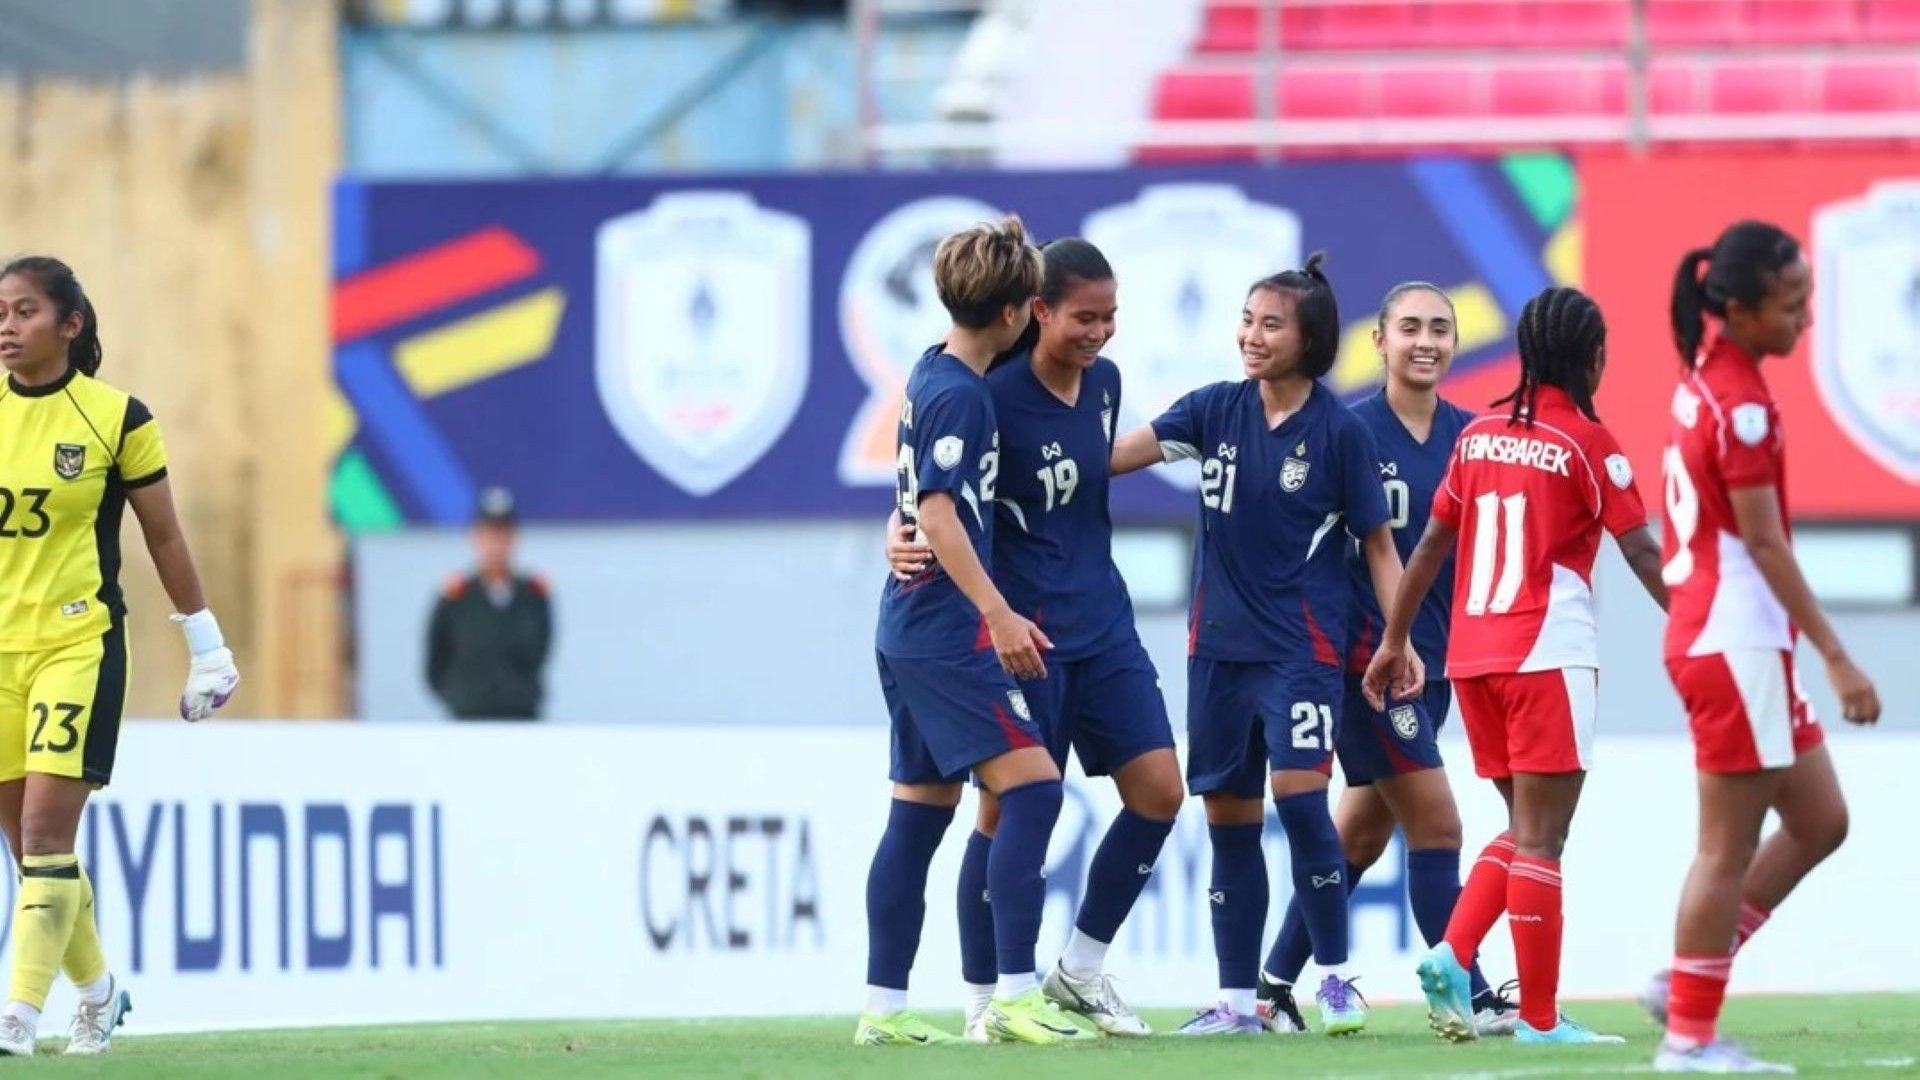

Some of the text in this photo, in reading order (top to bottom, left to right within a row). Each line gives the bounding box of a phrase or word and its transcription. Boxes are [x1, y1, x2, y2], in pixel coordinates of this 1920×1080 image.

[1467, 433, 1572, 477] BINSBAREK
[1036, 458, 1079, 512] 19
[1202, 458, 1236, 514] 21
[0, 487, 52, 538] 23
[1465, 490, 1527, 616] 11
[29, 702, 86, 754] 23
[1291, 701, 1333, 751] 21
[88, 802, 444, 974] YUNDAI
[639, 814, 825, 952] CRETA
